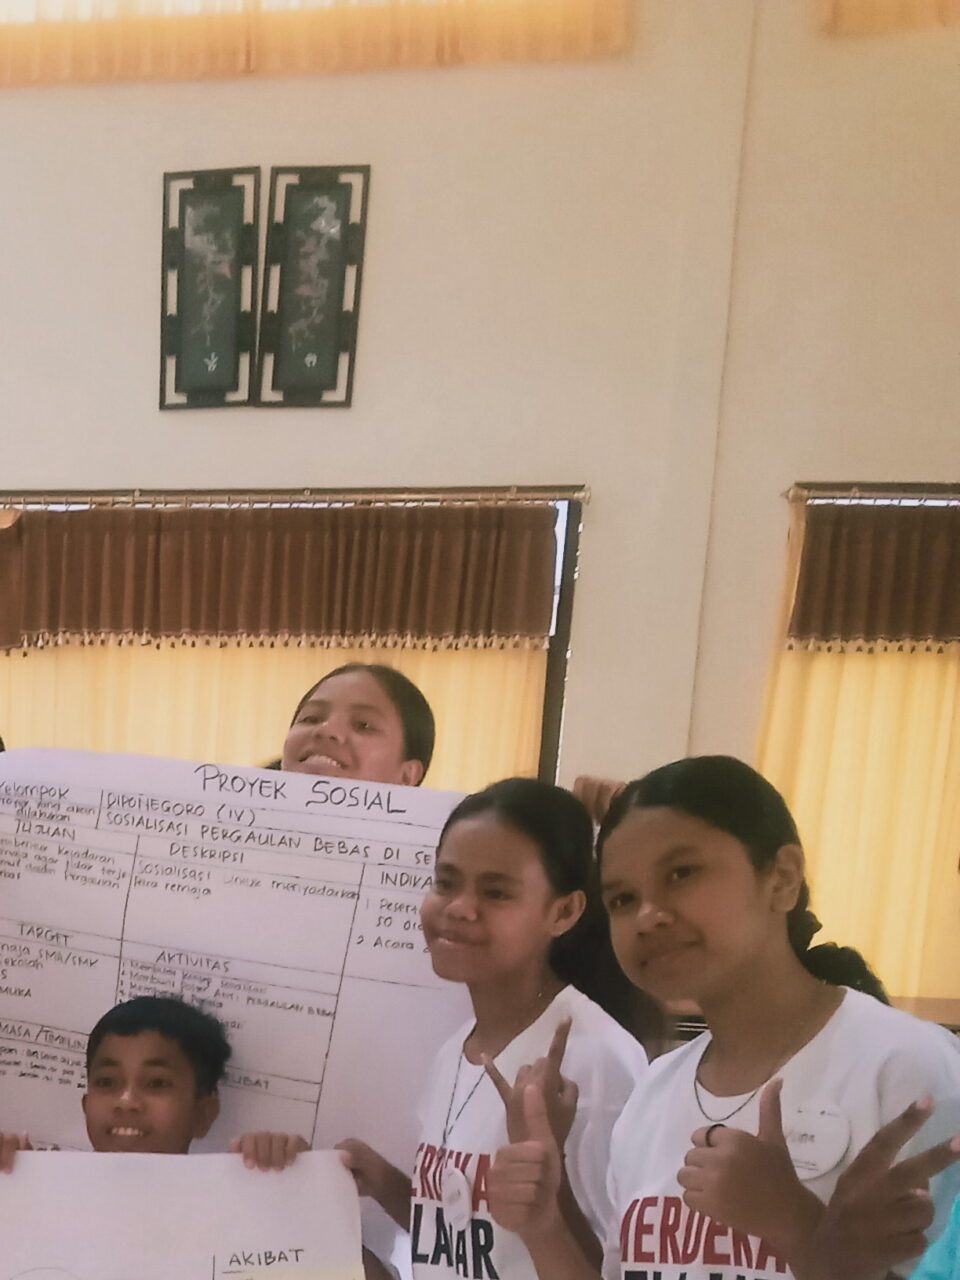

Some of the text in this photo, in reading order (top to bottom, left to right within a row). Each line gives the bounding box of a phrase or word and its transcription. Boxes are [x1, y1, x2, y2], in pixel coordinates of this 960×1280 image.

[194, 764, 406, 814] PROYEK SOSIAL
[15, 818, 76, 841] TUJUAN
[106, 812, 188, 836] SOSIALISASI
[201, 824, 302, 849] PERGAULAN
[313, 836, 370, 858] BEBAS
[384, 847, 400, 860] DI
[169, 842, 244, 864] DESKRIPSI
[19, 922, 72, 946] TARGET
[156, 951, 230, 973] AKTIVITAS
[228, 1249, 304, 1266] AKIBAT
